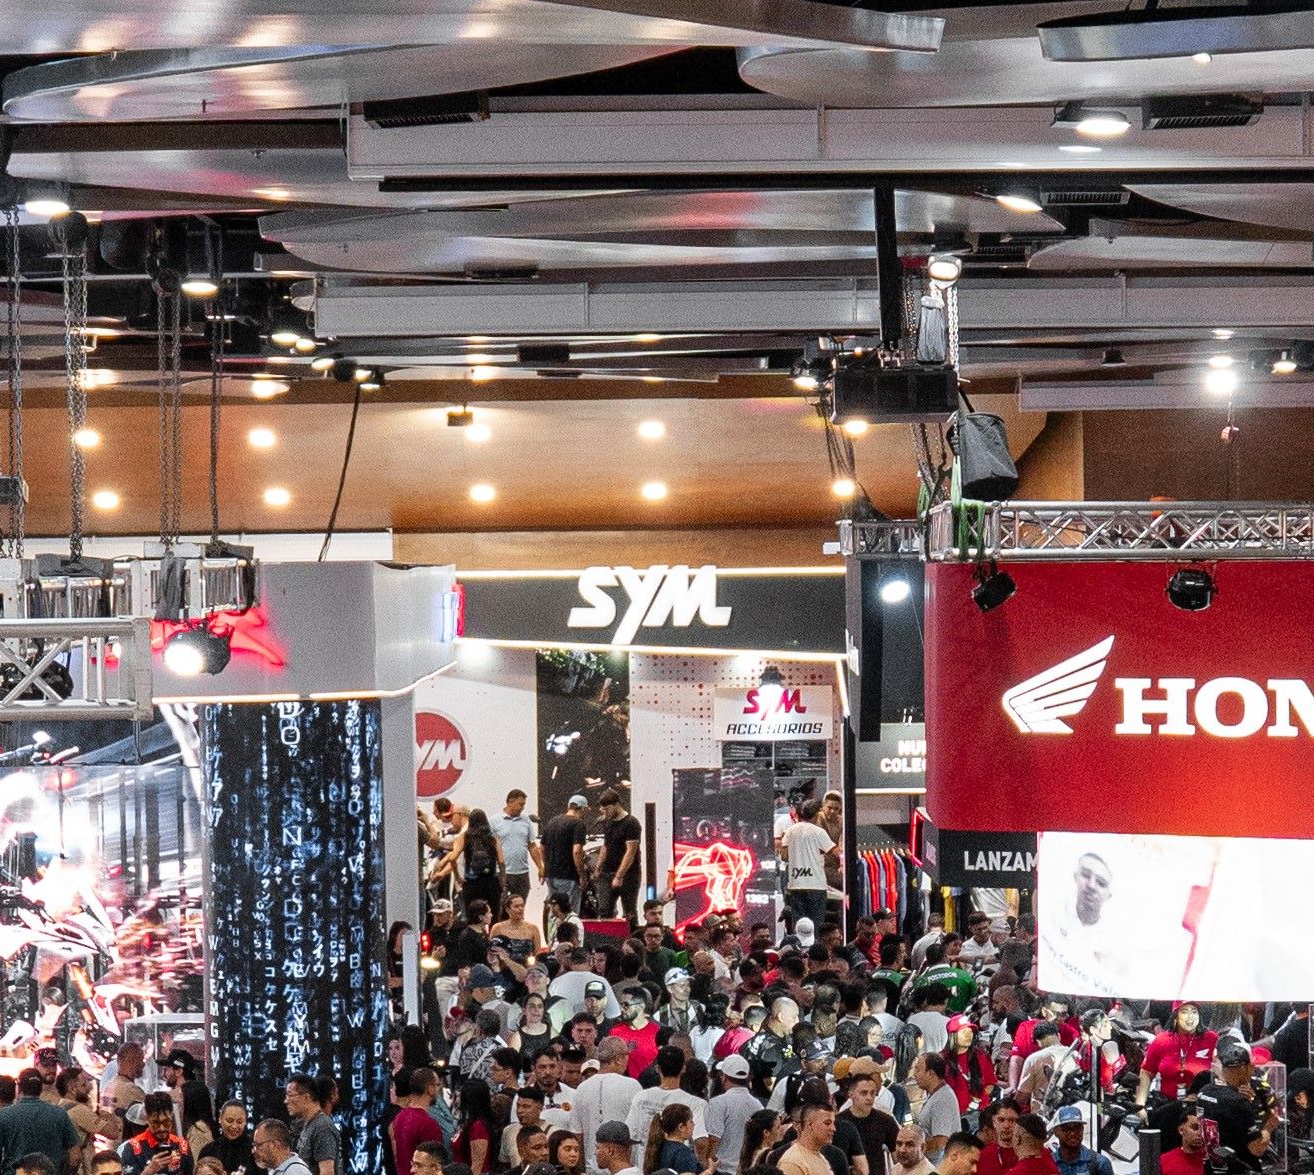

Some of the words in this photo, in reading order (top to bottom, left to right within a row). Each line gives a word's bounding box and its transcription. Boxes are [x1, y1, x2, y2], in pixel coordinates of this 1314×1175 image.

[567, 564, 733, 646] SYM
[726, 722, 823, 736] ACCESORIOS
[414, 739, 466, 771] YM
[880, 757, 927, 774] COLE
